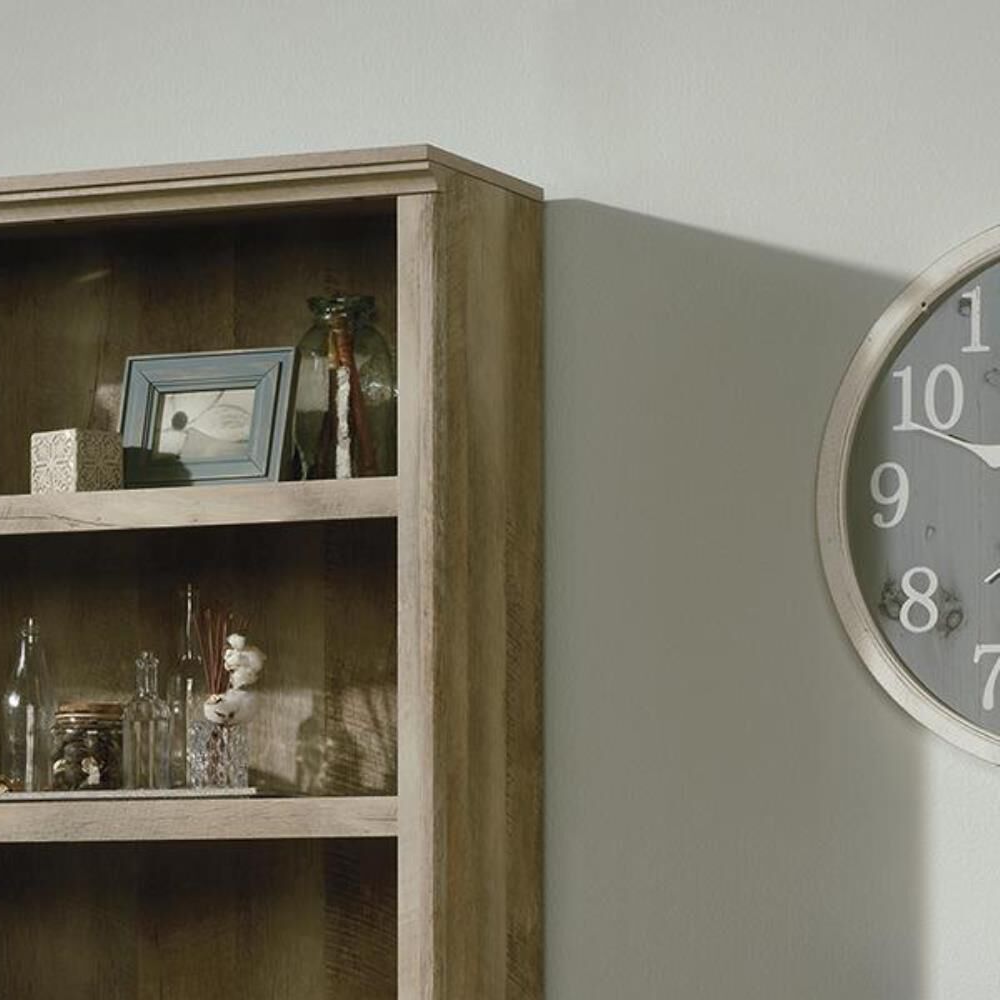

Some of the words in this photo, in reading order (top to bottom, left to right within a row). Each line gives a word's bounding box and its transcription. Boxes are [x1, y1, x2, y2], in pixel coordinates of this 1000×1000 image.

[892, 363, 964, 430] 10
[870, 461, 909, 528] 9
[900, 567, 939, 633] 8
[973, 644, 1000, 711] 7
